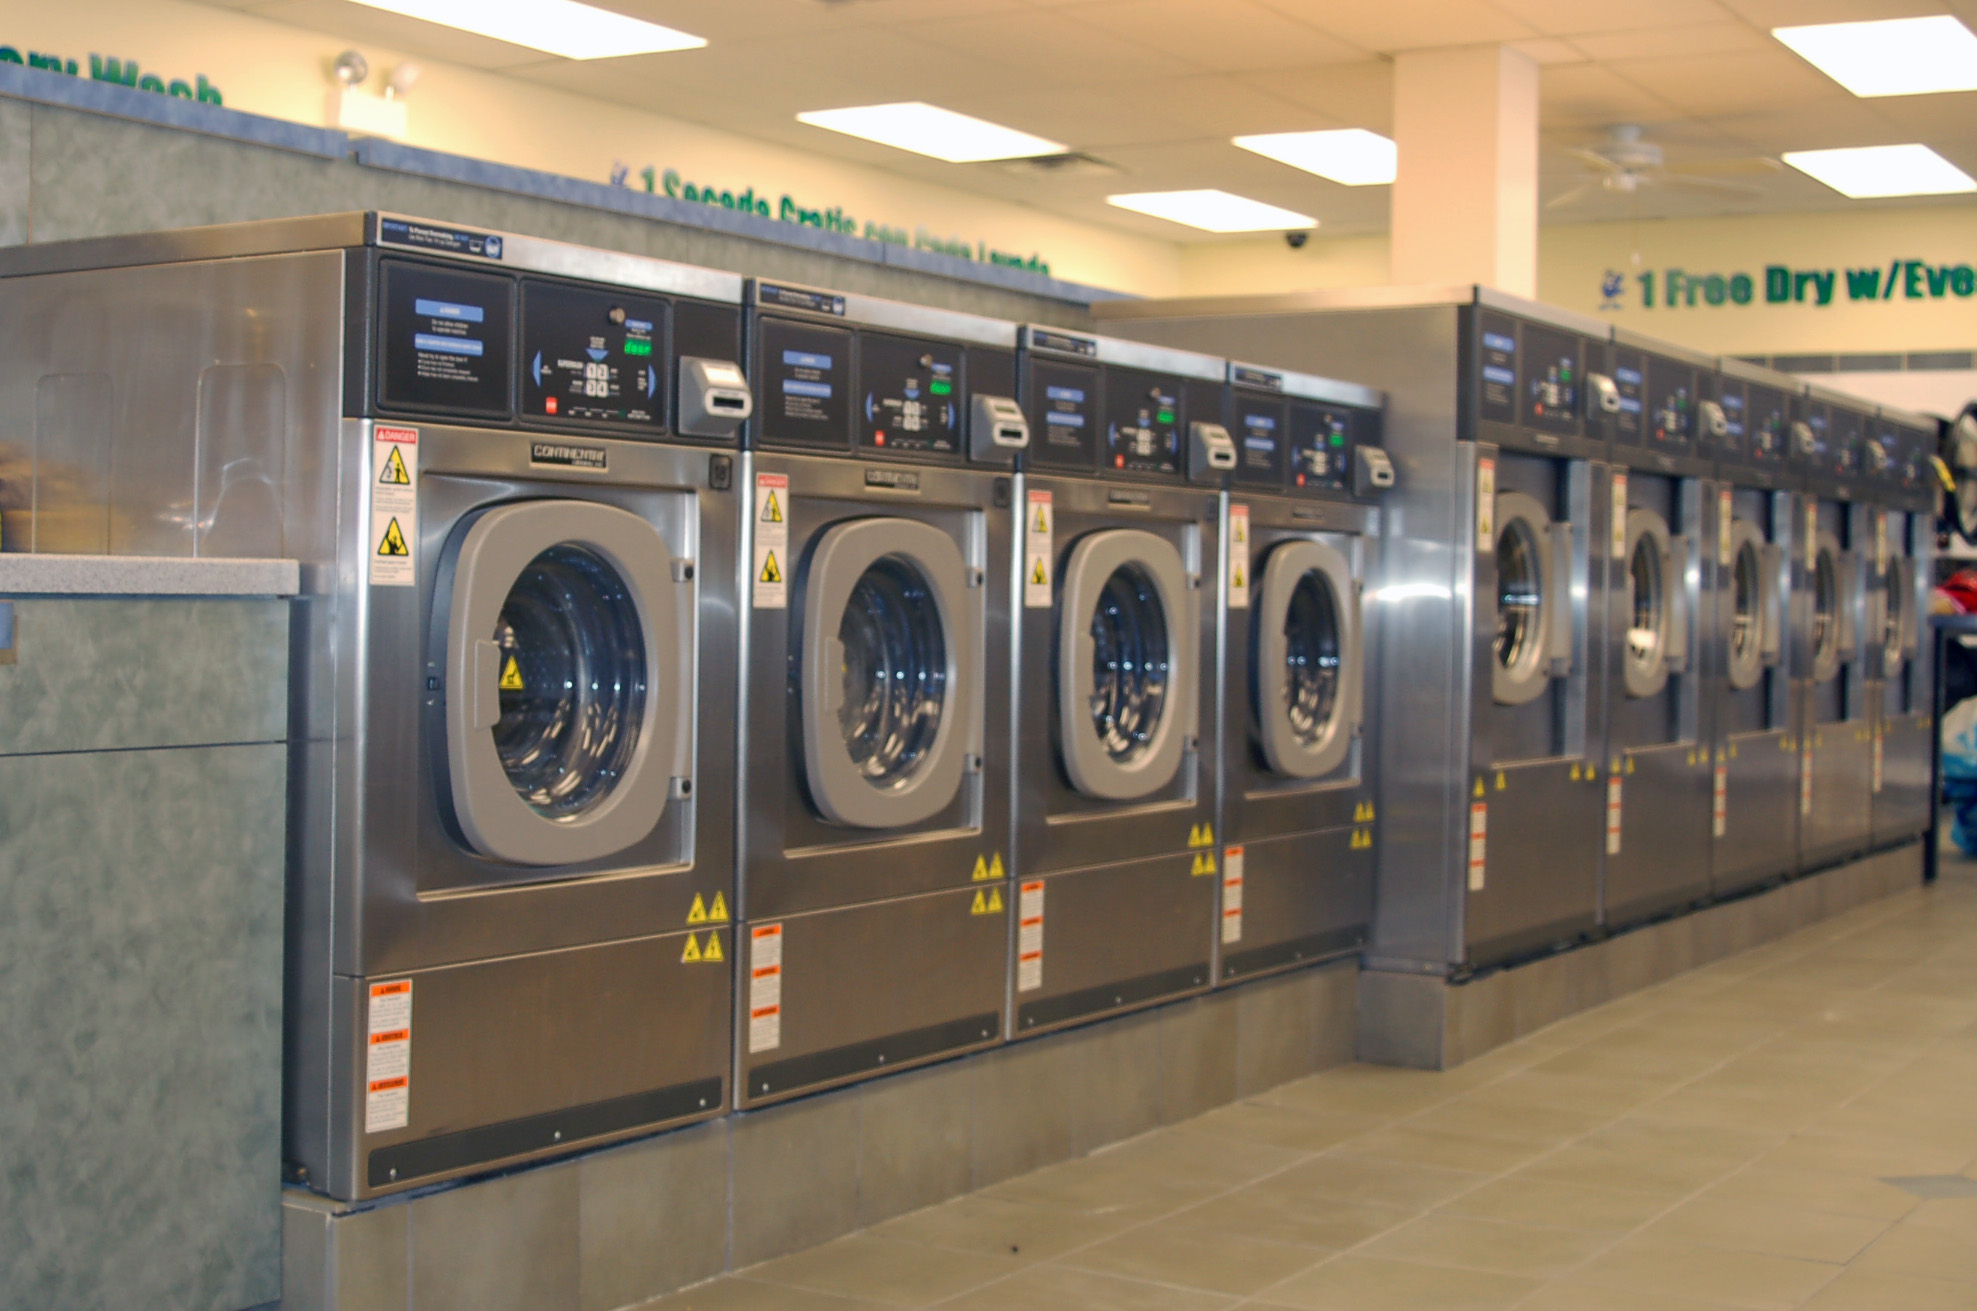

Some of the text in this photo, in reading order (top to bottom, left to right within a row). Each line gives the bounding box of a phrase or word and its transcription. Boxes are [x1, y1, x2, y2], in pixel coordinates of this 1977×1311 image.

[1637, 269, 1655, 308] 1
[1665, 268, 1754, 307] Free
[1765, 263, 1836, 307] Dry
[383, 429, 416, 442] DANGER
